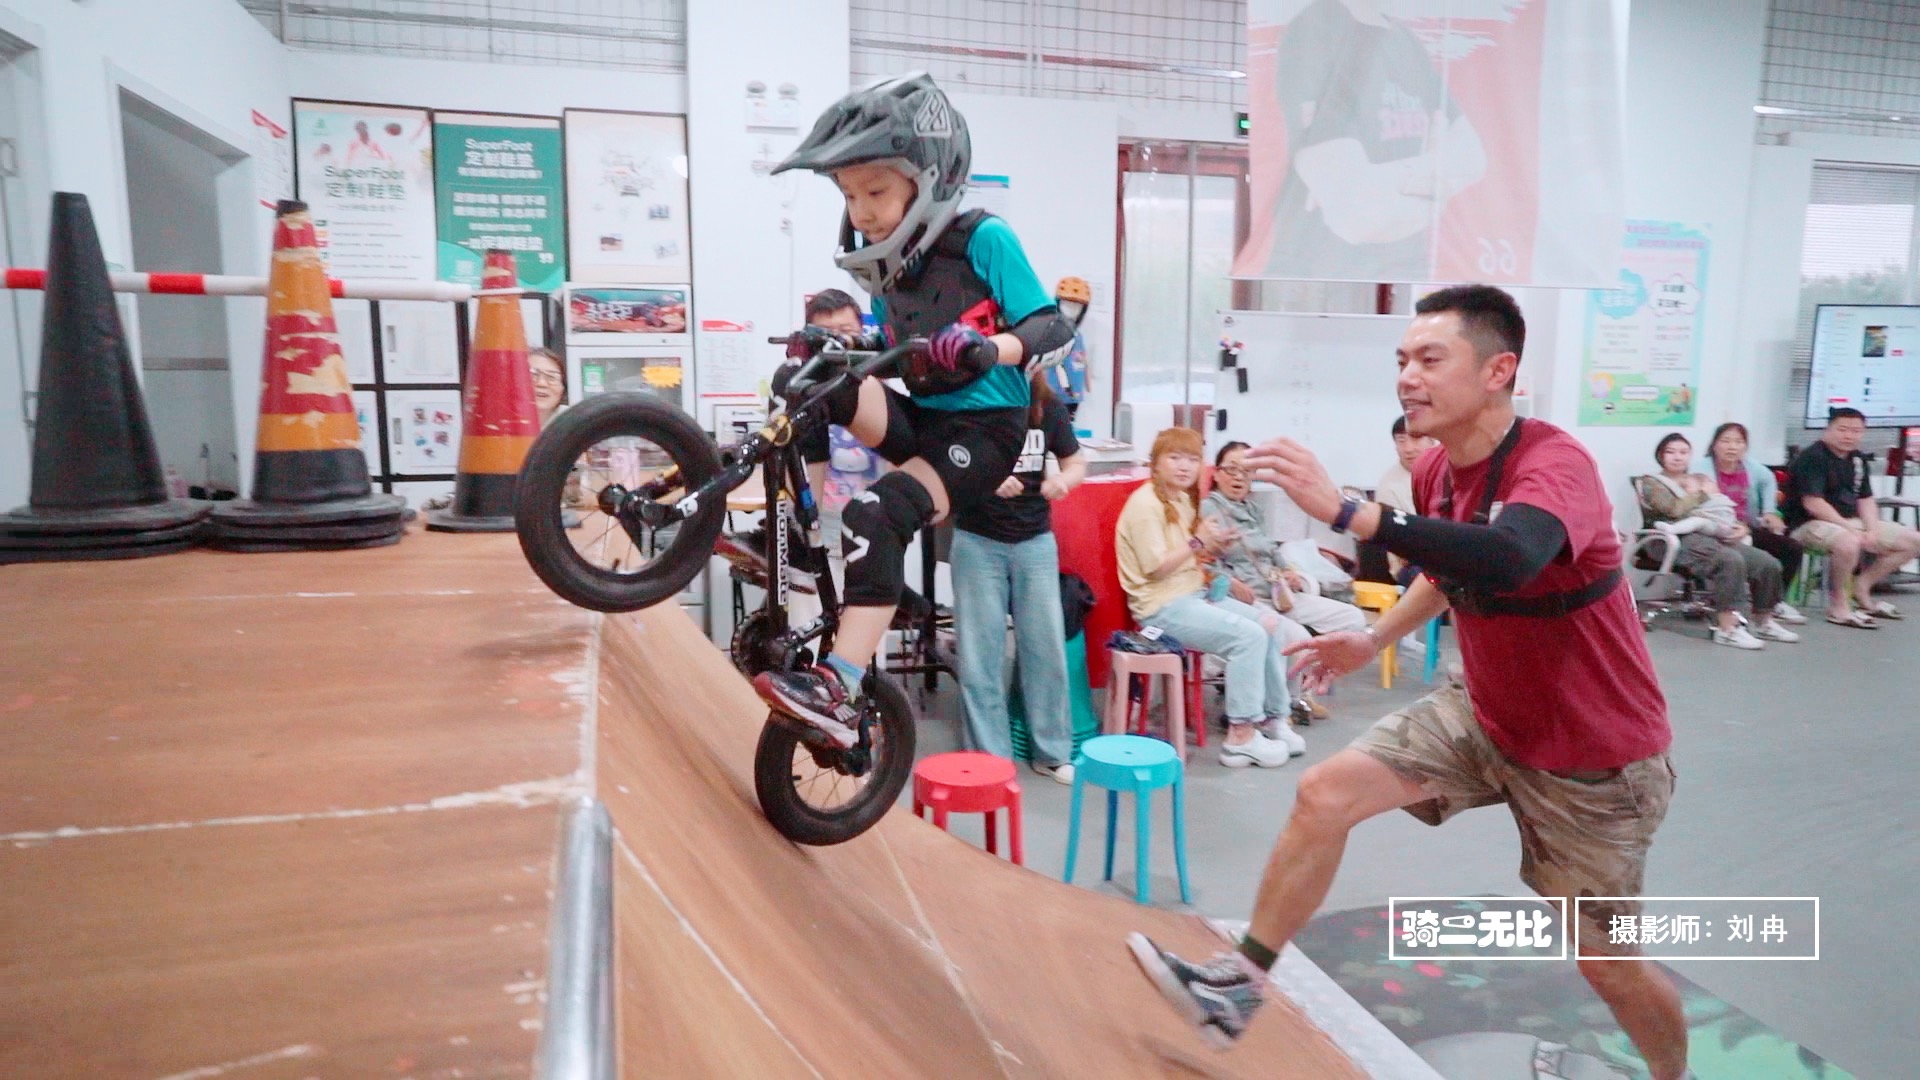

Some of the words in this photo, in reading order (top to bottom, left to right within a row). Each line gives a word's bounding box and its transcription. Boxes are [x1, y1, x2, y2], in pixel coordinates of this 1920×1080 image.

[465, 138, 533, 152] SuperFoot
[464, 151, 534, 168] 定制鞋垫
[324, 165, 406, 180] SuperFoot
[325, 182, 406, 201] 定制鞋垫
